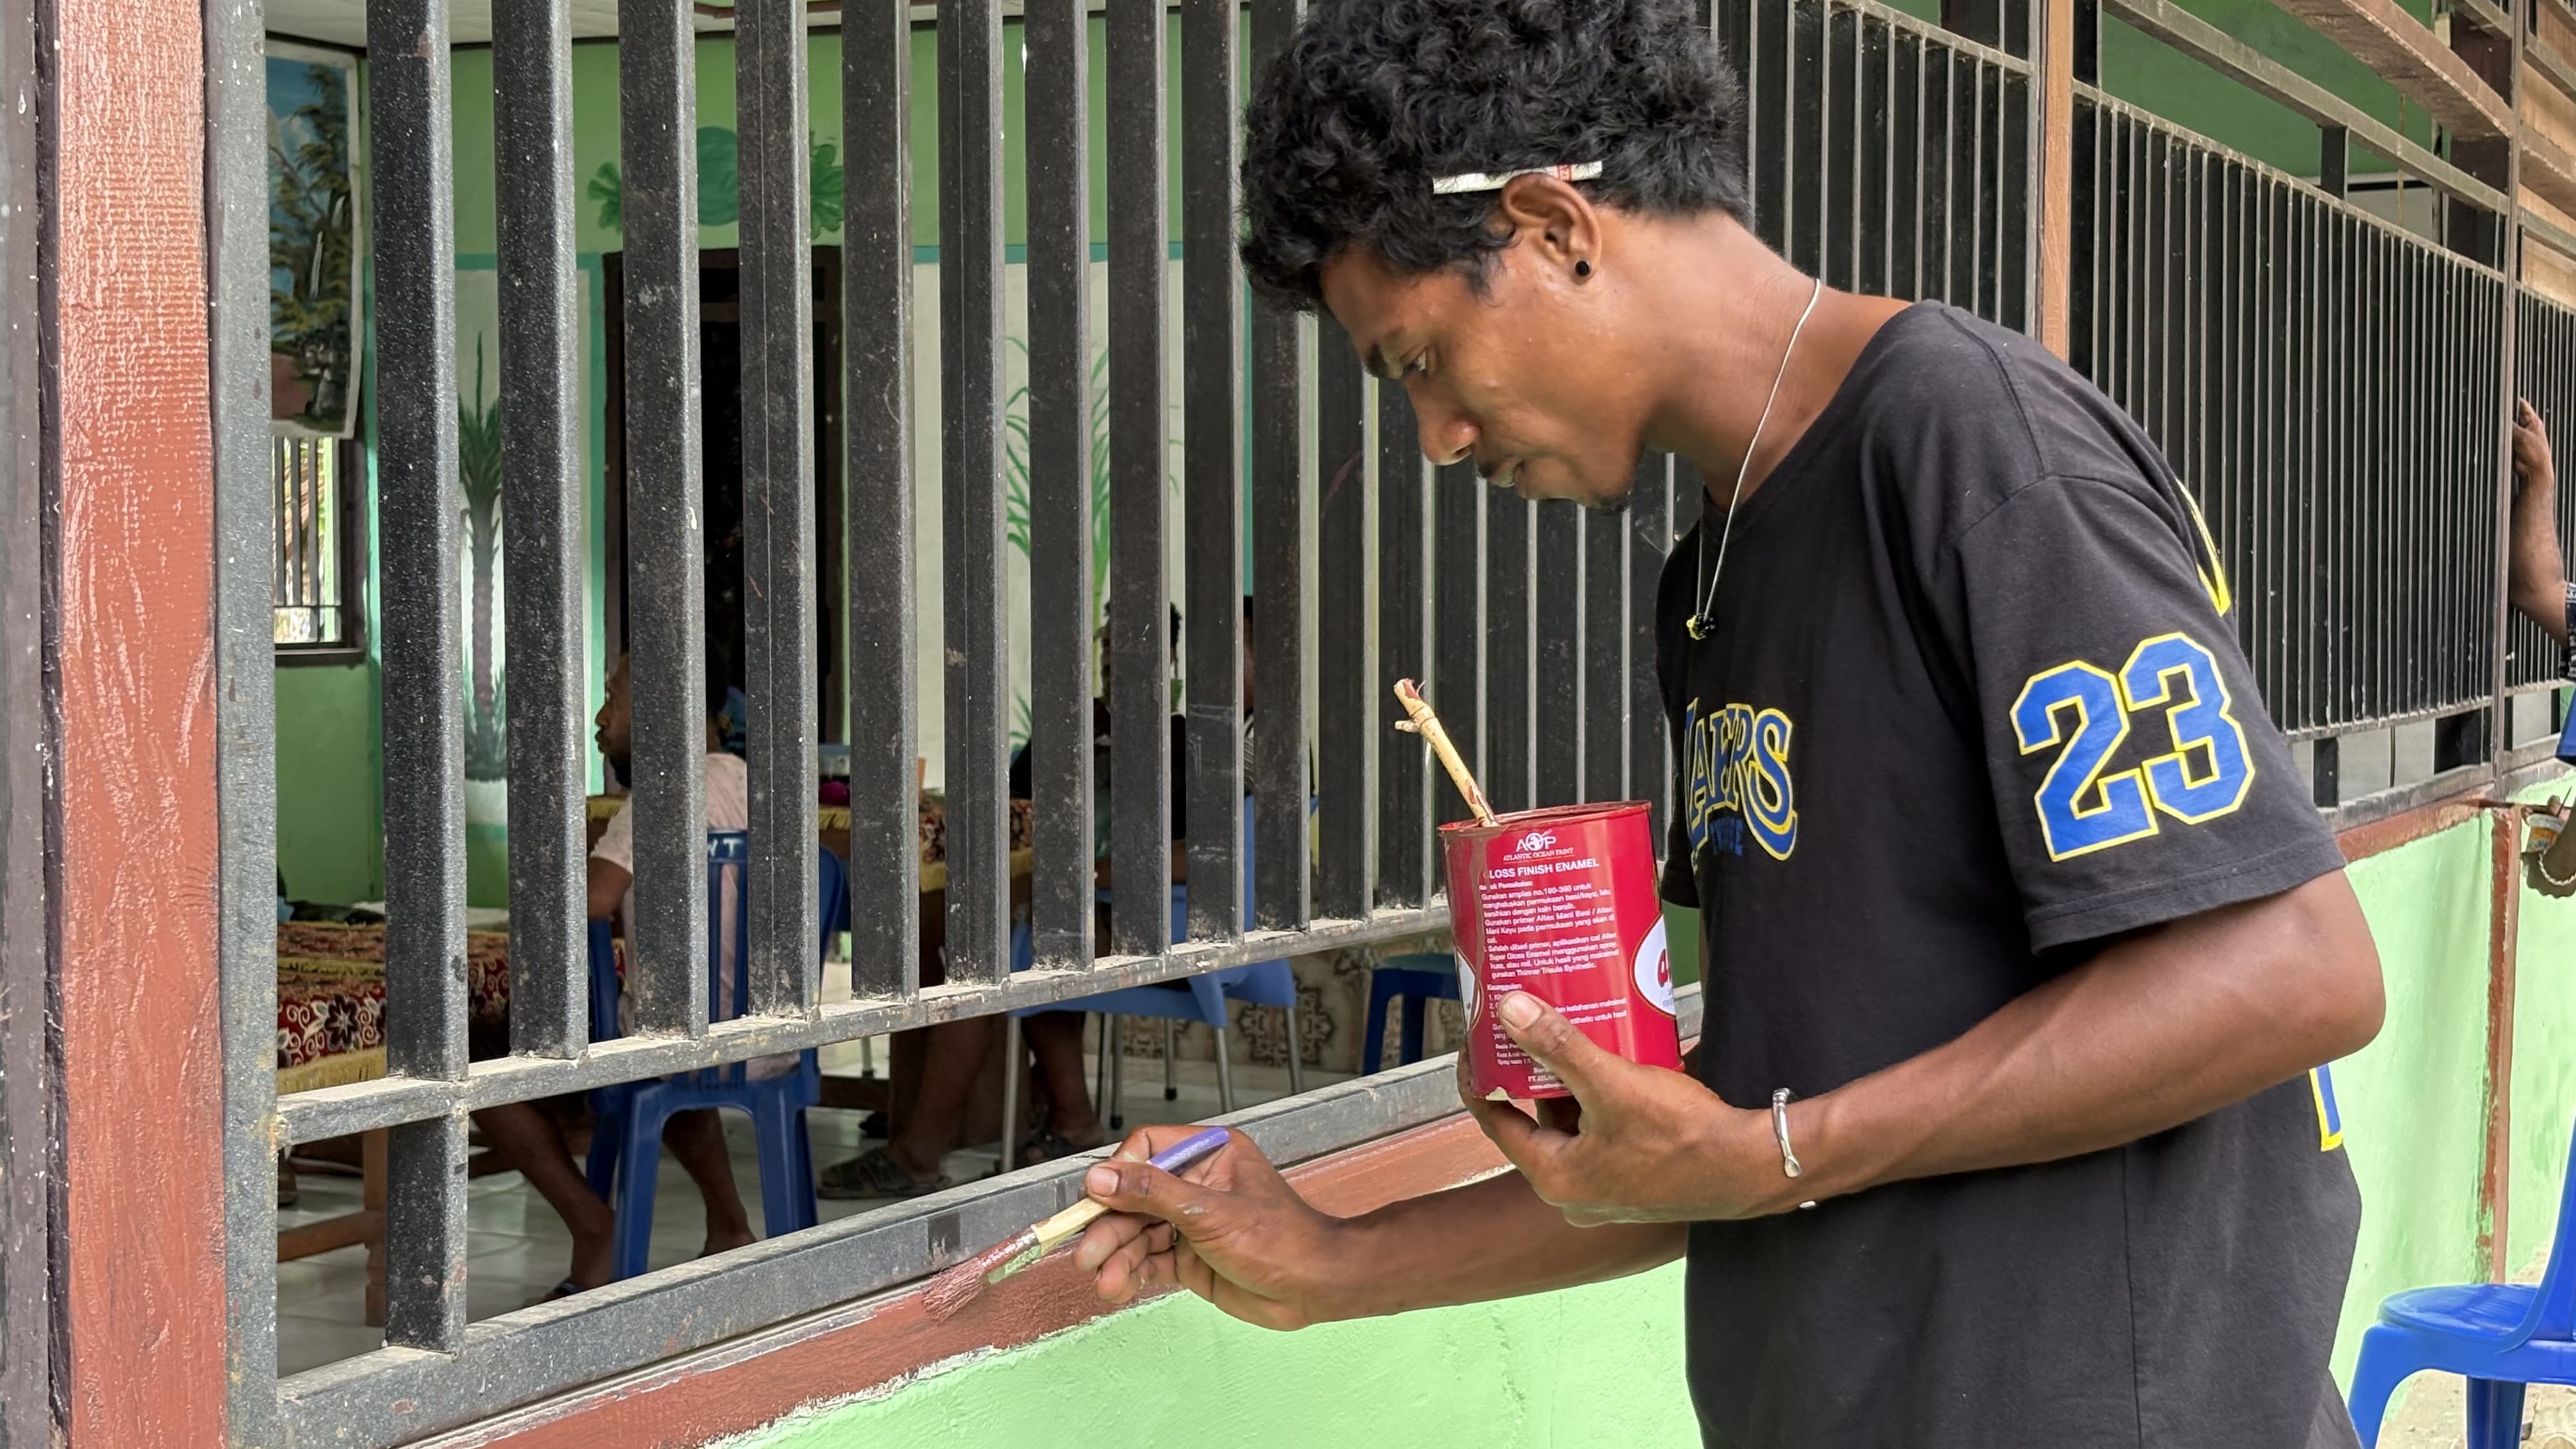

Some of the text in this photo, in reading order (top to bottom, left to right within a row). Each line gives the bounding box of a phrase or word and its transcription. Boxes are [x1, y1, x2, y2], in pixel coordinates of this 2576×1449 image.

[2010, 632, 2255, 862] 23
[1517, 864, 1552, 877] FINISH
[1555, 858, 1600, 872] ENAMEL
[1513, 917, 1535, 926] primer
[1575, 919, 1591, 928] yang
[1533, 958, 1554, 966] Untuk
[1572, 954, 1588, 963] yang
